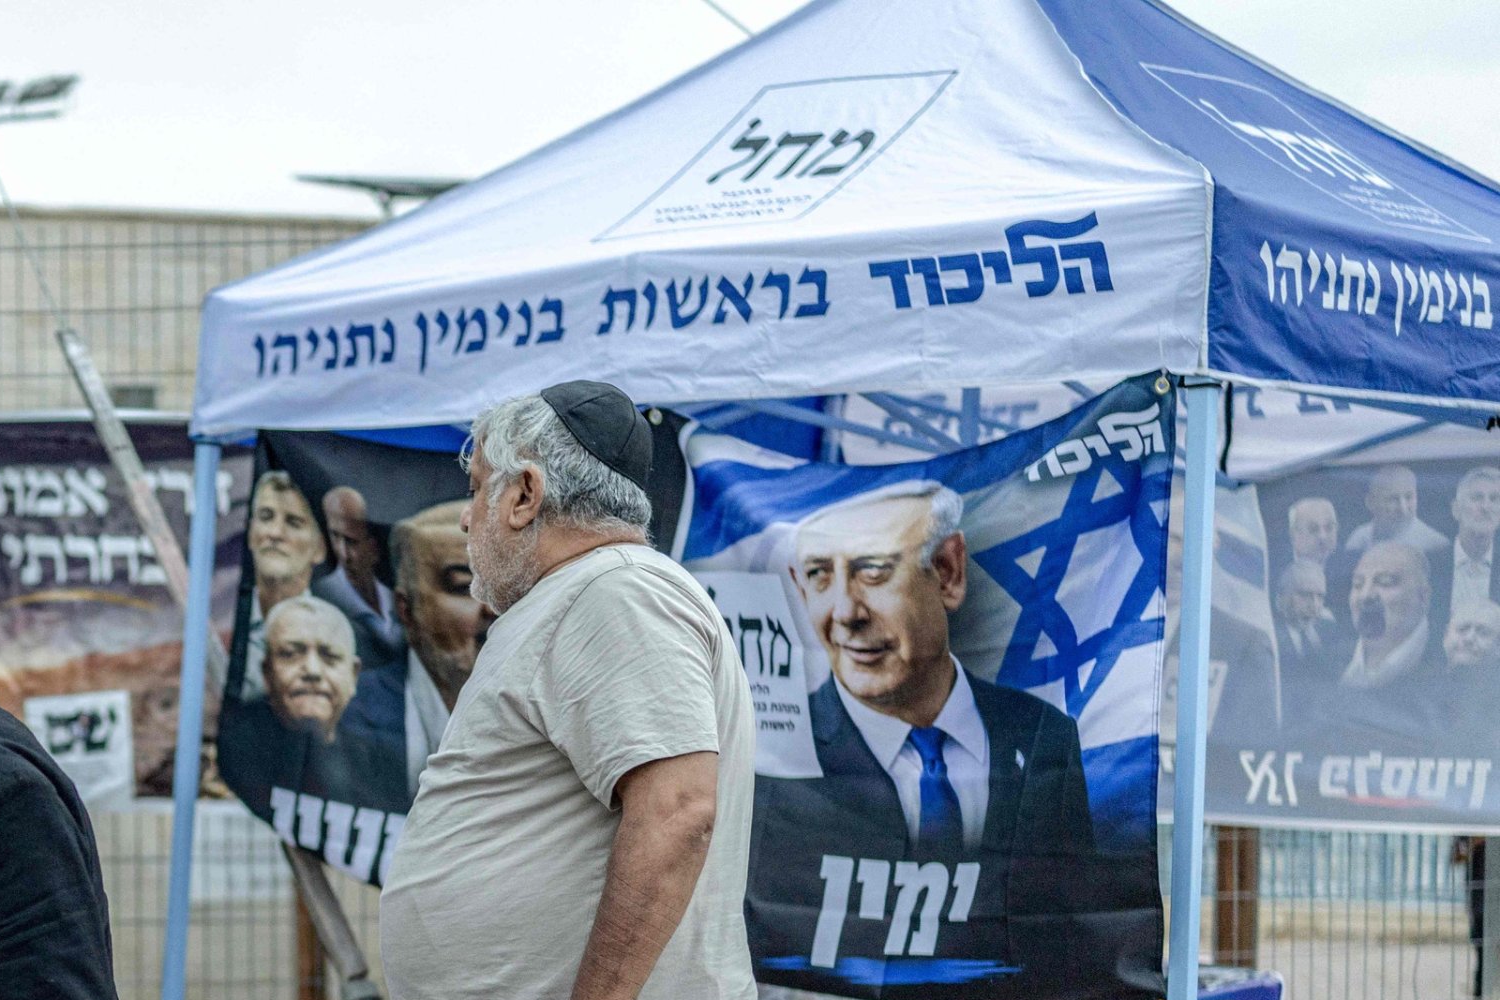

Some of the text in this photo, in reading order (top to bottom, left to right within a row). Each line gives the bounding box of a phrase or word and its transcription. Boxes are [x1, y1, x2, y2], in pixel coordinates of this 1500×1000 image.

[707, 117, 876, 184] מחל
[252, 210, 1115, 378] הליכוד בראשות בנימין נתניהו
[1260, 240, 1494, 337] בנימין נתניהו
[810, 854, 981, 968] ימין
